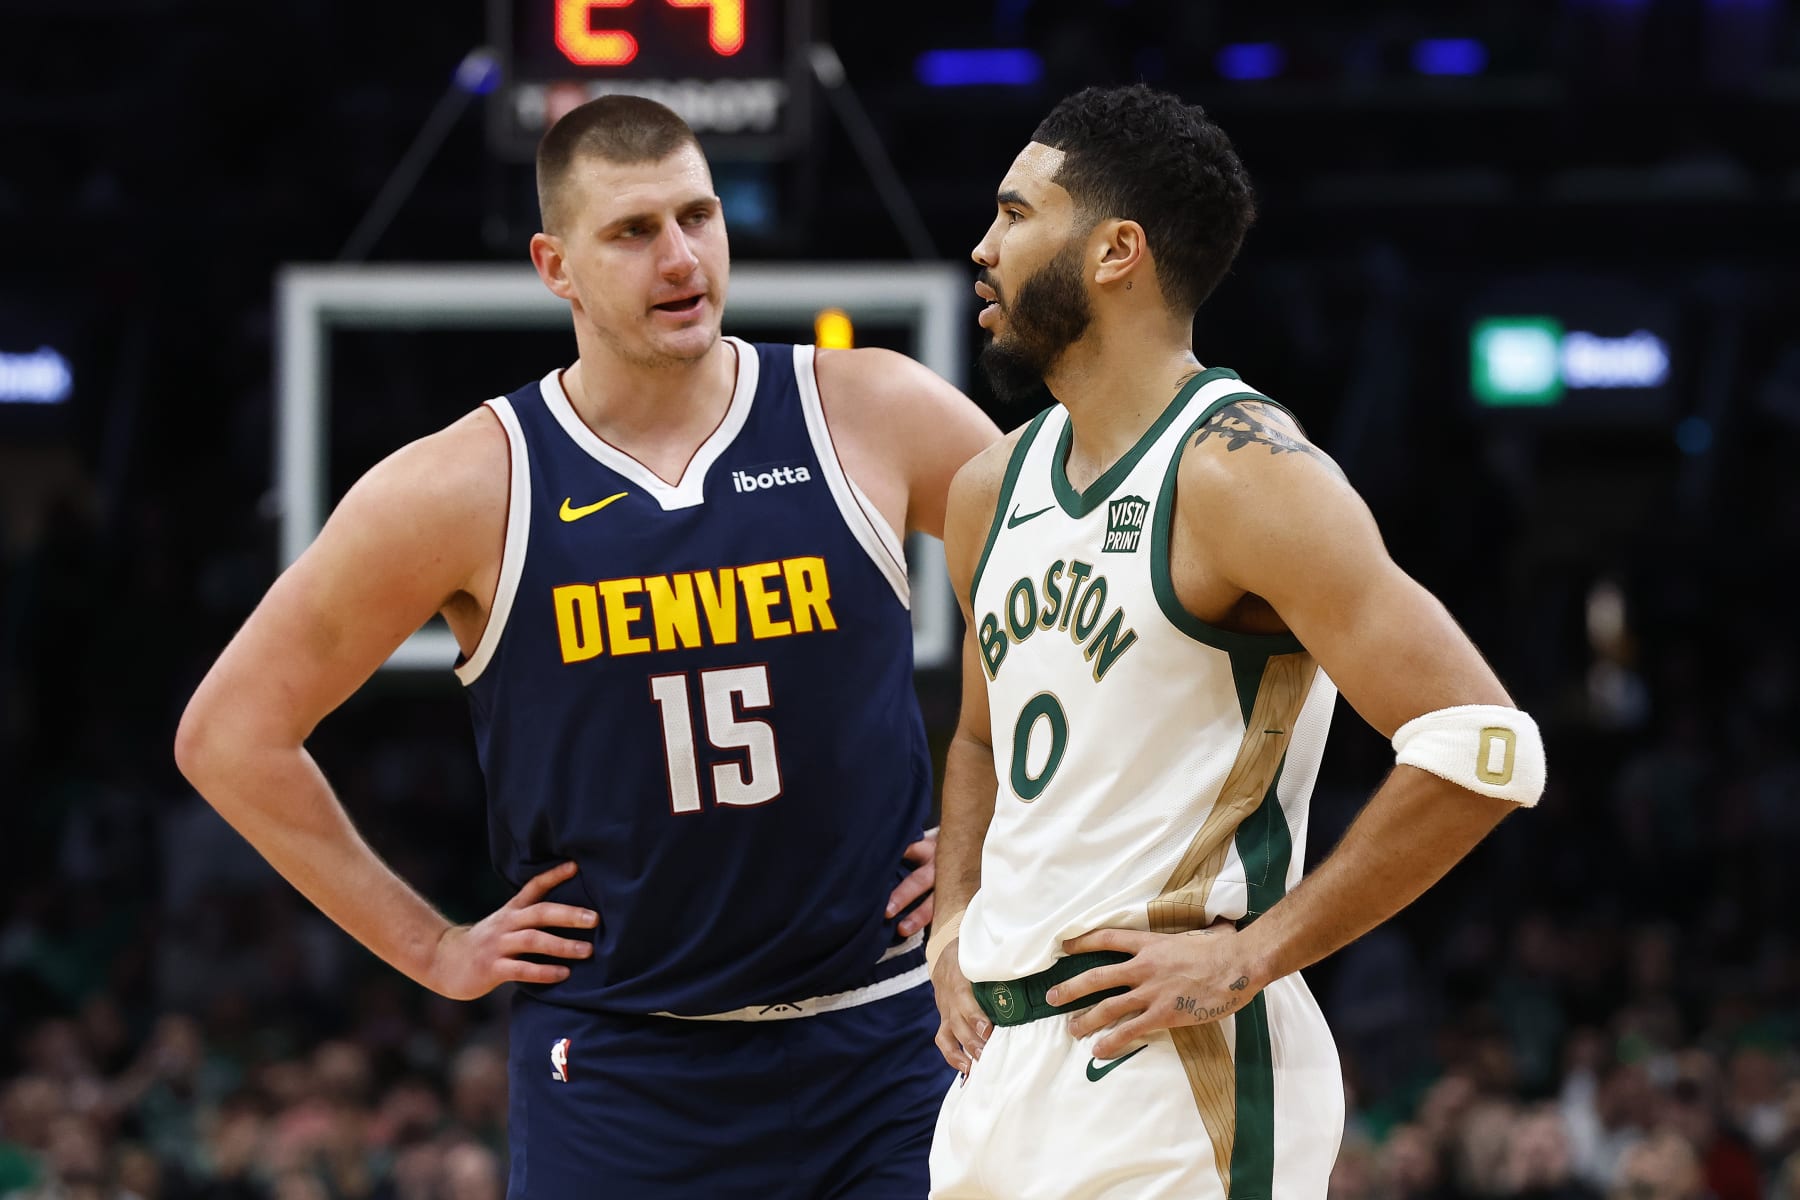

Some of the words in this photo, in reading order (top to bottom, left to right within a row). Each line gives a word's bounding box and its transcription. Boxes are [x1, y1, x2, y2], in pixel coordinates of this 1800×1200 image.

[732, 465, 811, 493] ibotta
[1105, 531, 1140, 550] PRINT
[1112, 502, 1146, 529] VISTA
[553, 555, 838, 664] DENVER
[979, 559, 1138, 683] BOSTON
[649, 662, 783, 815] 15
[1009, 690, 1069, 803] 0
[1476, 727, 1516, 786] 0
[1175, 996, 1197, 1014] Big
[1194, 997, 1240, 1021] Deuce
